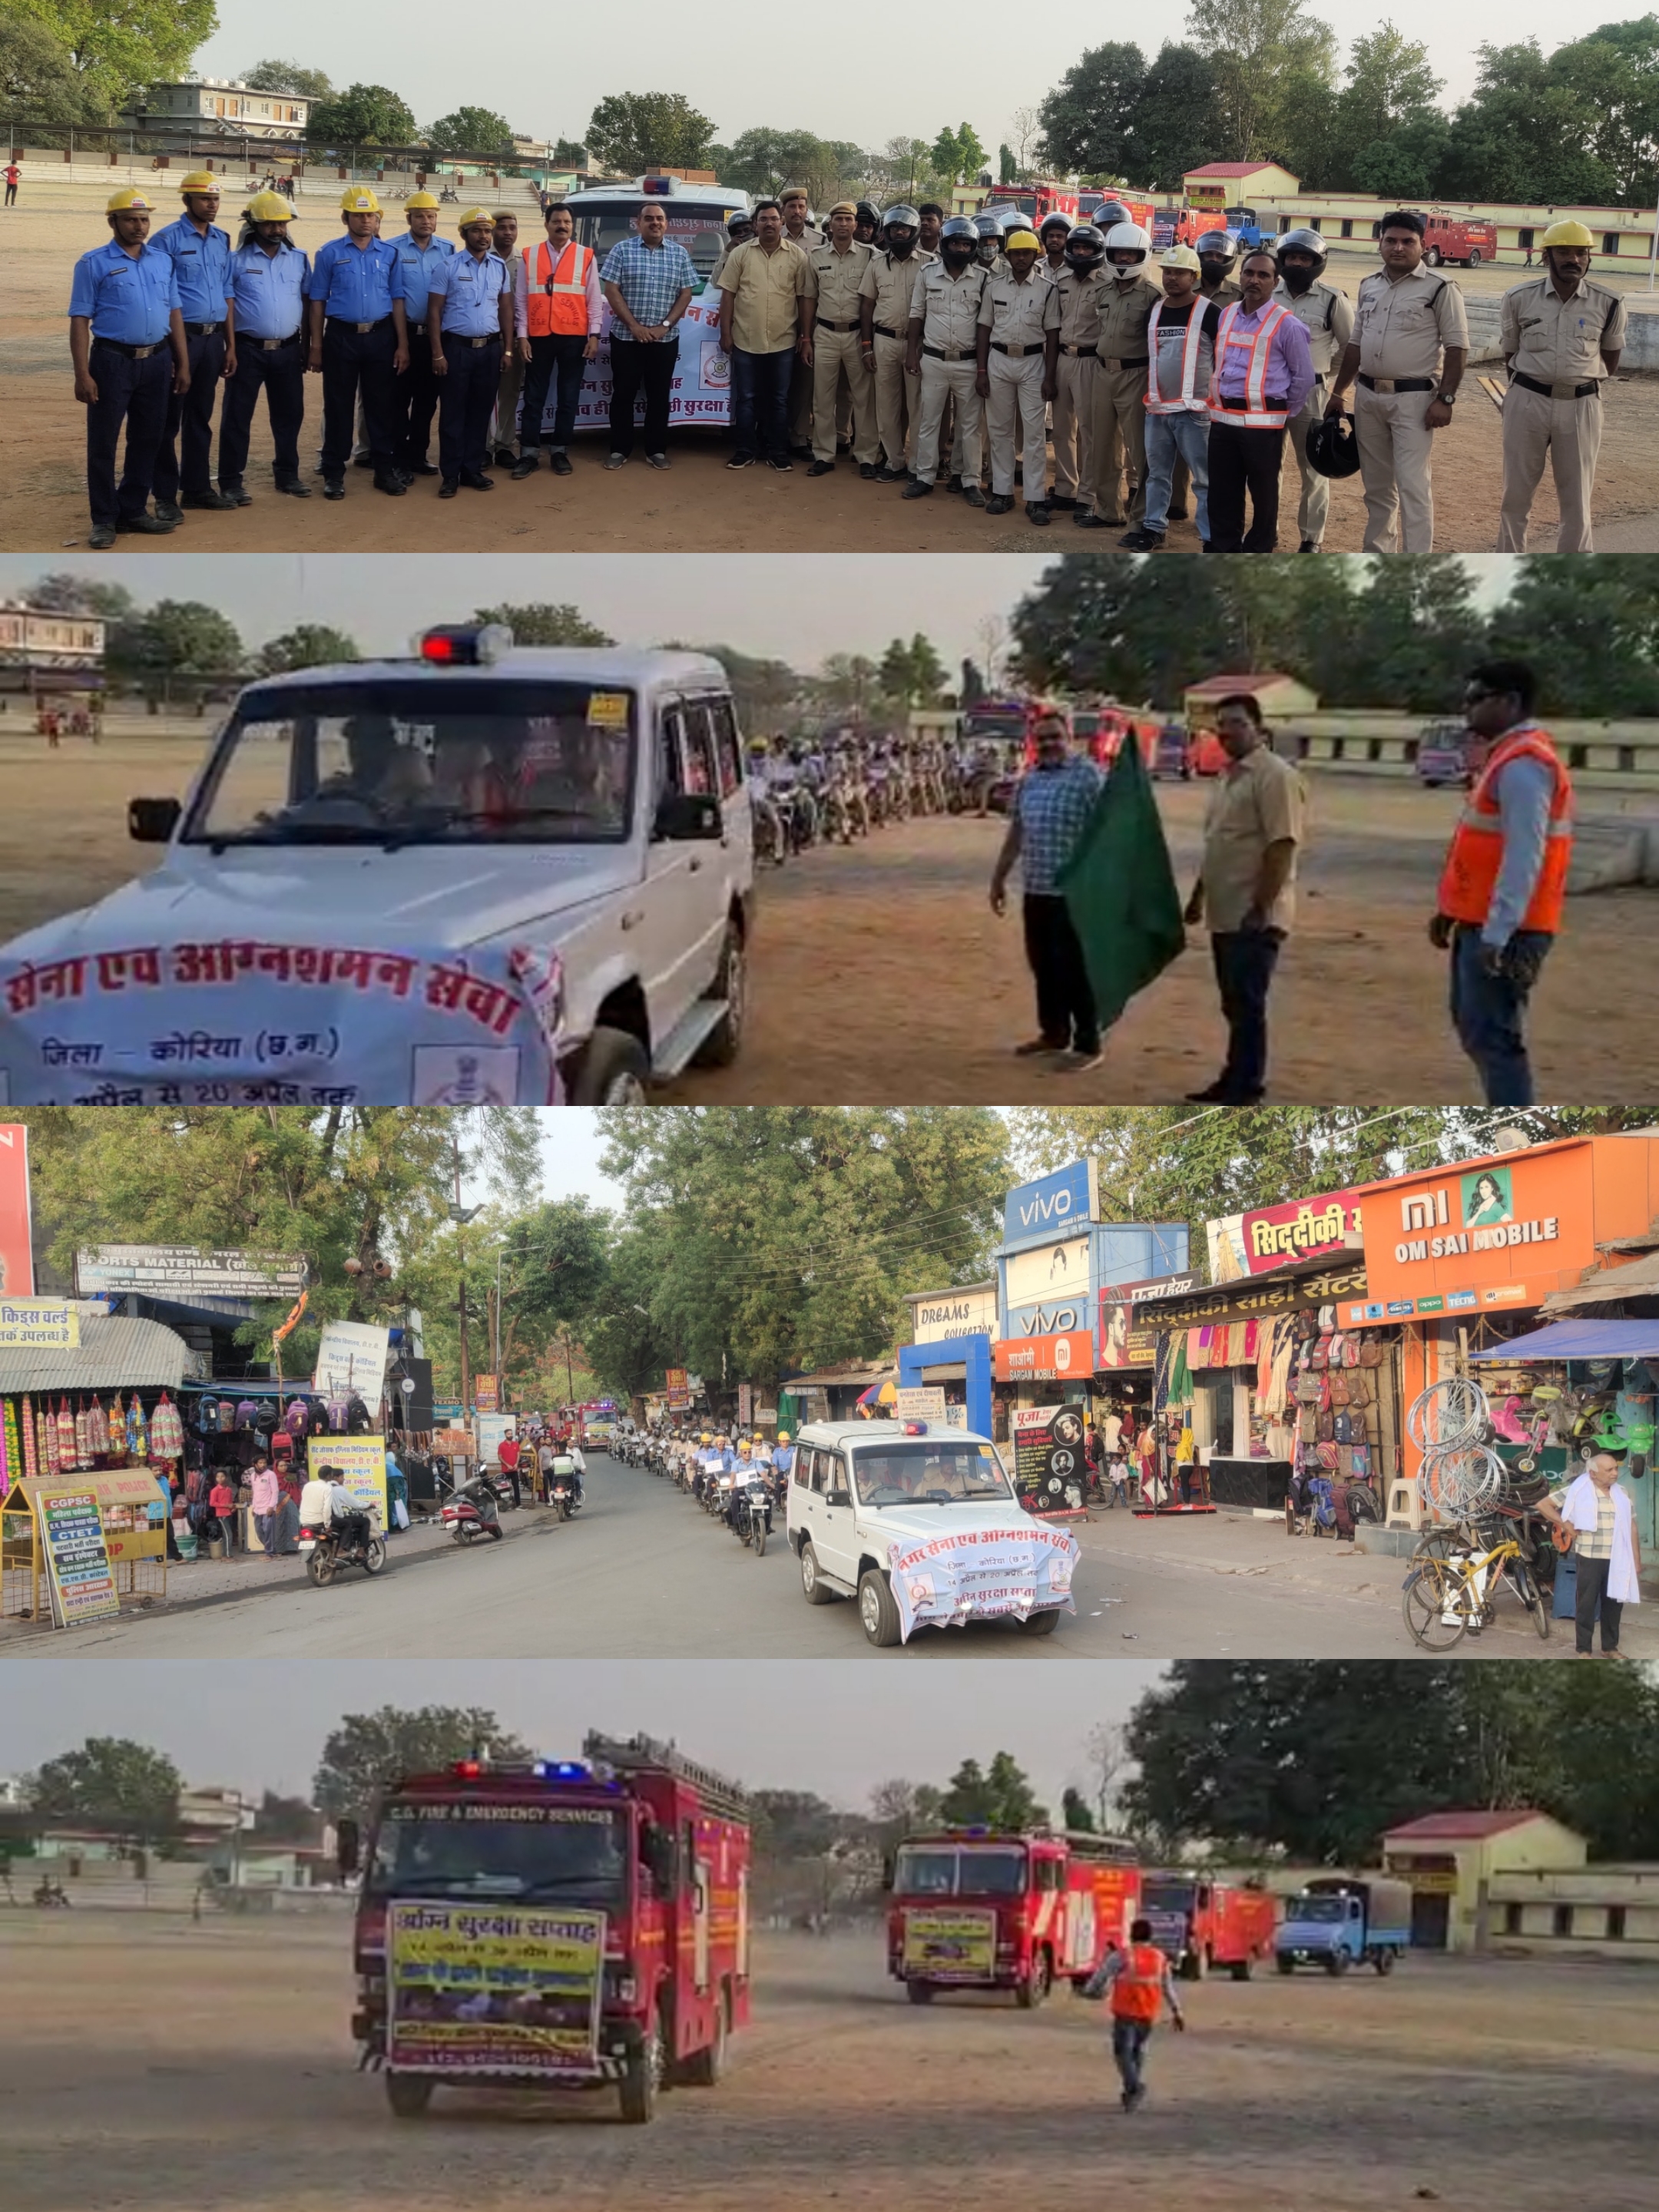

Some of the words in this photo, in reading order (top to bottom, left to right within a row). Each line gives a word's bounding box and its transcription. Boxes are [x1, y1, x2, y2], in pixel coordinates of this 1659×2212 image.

[1156, 328, 1186, 336] FASHION
[684, 399, 724, 416] सुरक्षा
[426, 958, 522, 1035] सेवा
[41, 1037, 104, 1066] जिला
[149, 1031, 243, 1061] कोरिया
[1020, 1189, 1071, 1227] vivo
[1395, 1240, 1429, 1263] OM
[1431, 1233, 1469, 1258] SAI
[1472, 1217, 1559, 1252] MOBILE
[78, 1254, 140, 1267] SPORTS
[144, 1257, 221, 1270] MATERIAL
[101, 1268, 131, 1277] YONEX
[1303, 1271, 1366, 1298] सेंटर
[1449, 1296, 1476, 1306] TECNO
[2, 1306, 41, 1327] किड्स
[921, 1303, 970, 1324] DREAMS
[1019, 1305, 1077, 1335] vivo
[20, 1331, 60, 1342] उपलब्ध
[61, 1327, 70, 1342] है
[1009, 1369, 1033, 1382] SARGAM
[1034, 1368, 1057, 1380] MOBILE
[1017, 1410, 1040, 1427] पूजा
[116, 1480, 151, 1493] POLICE
[50, 1496, 91, 1508] CGPSC
[58, 1528, 94, 1540] CTET
[899, 1548, 926, 1572] नगर
[926, 1537, 955, 1561] सेना
[948, 1561, 967, 1571] जिला
[979, 1556, 1005, 1568] कोरिया
[978, 1588, 1008, 1604] सुरक्षा
[419, 1806, 448, 1819] FIRE
